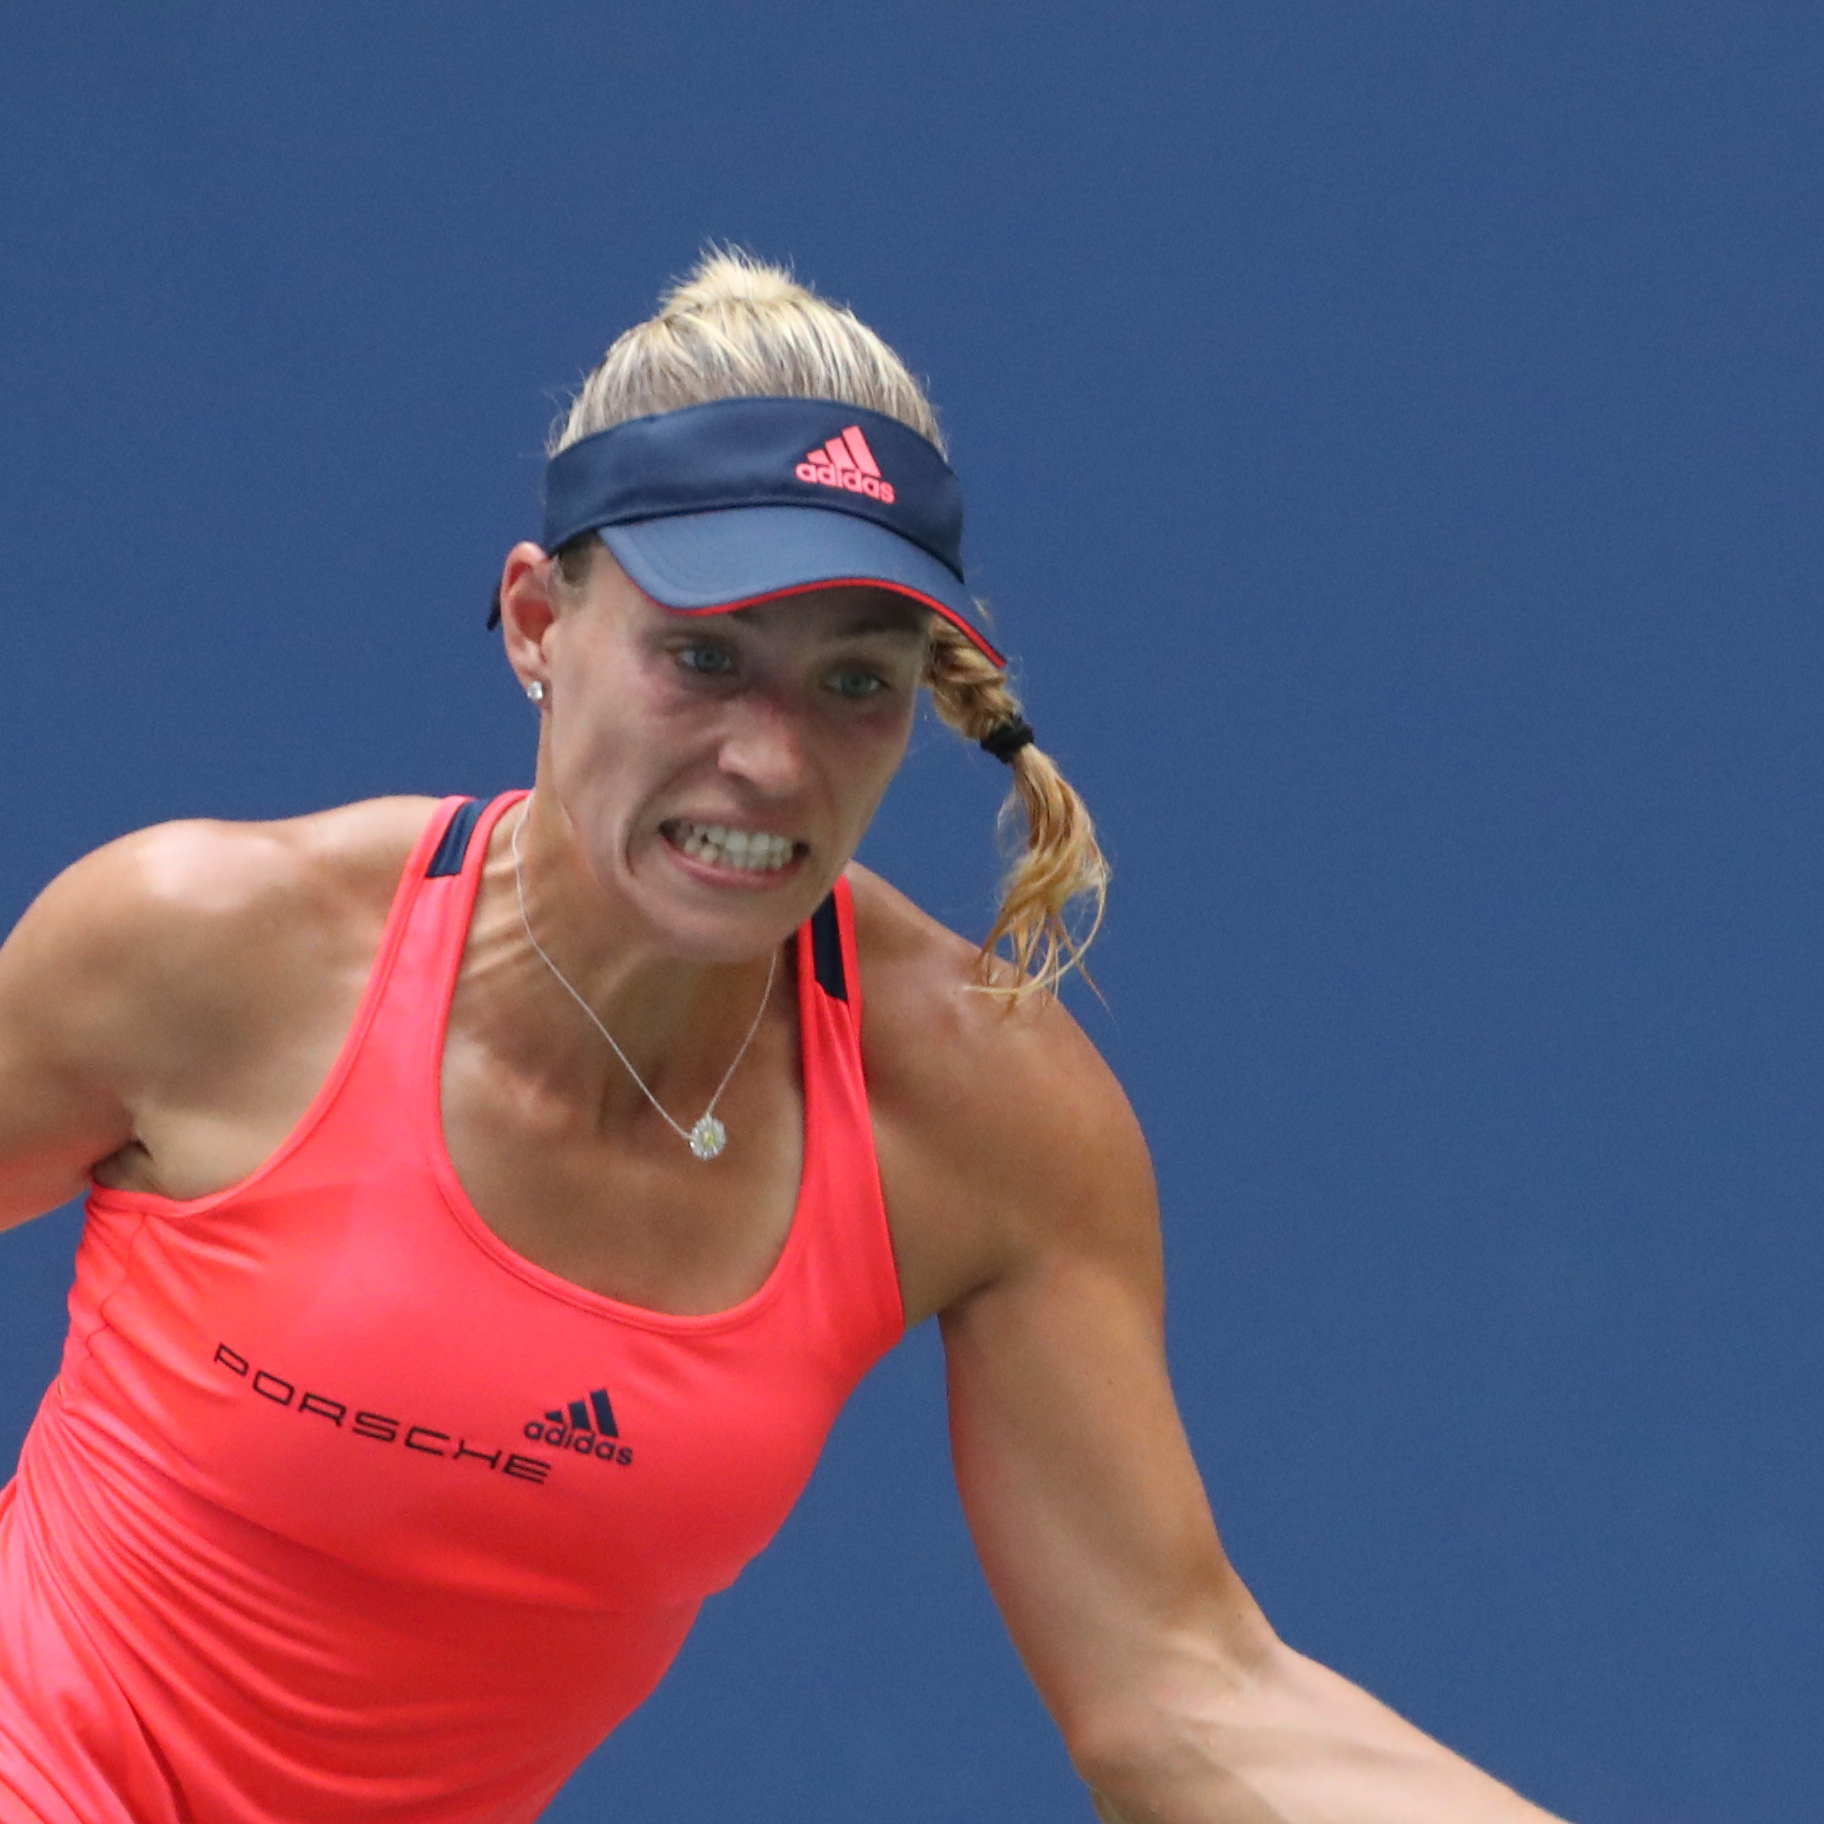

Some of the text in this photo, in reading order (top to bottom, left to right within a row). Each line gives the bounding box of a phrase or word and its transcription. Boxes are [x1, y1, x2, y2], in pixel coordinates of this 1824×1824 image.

[794, 462, 896, 504] adidas
[213, 1343, 552, 1485] PORSCHE
[523, 1421, 634, 1466] adidas
